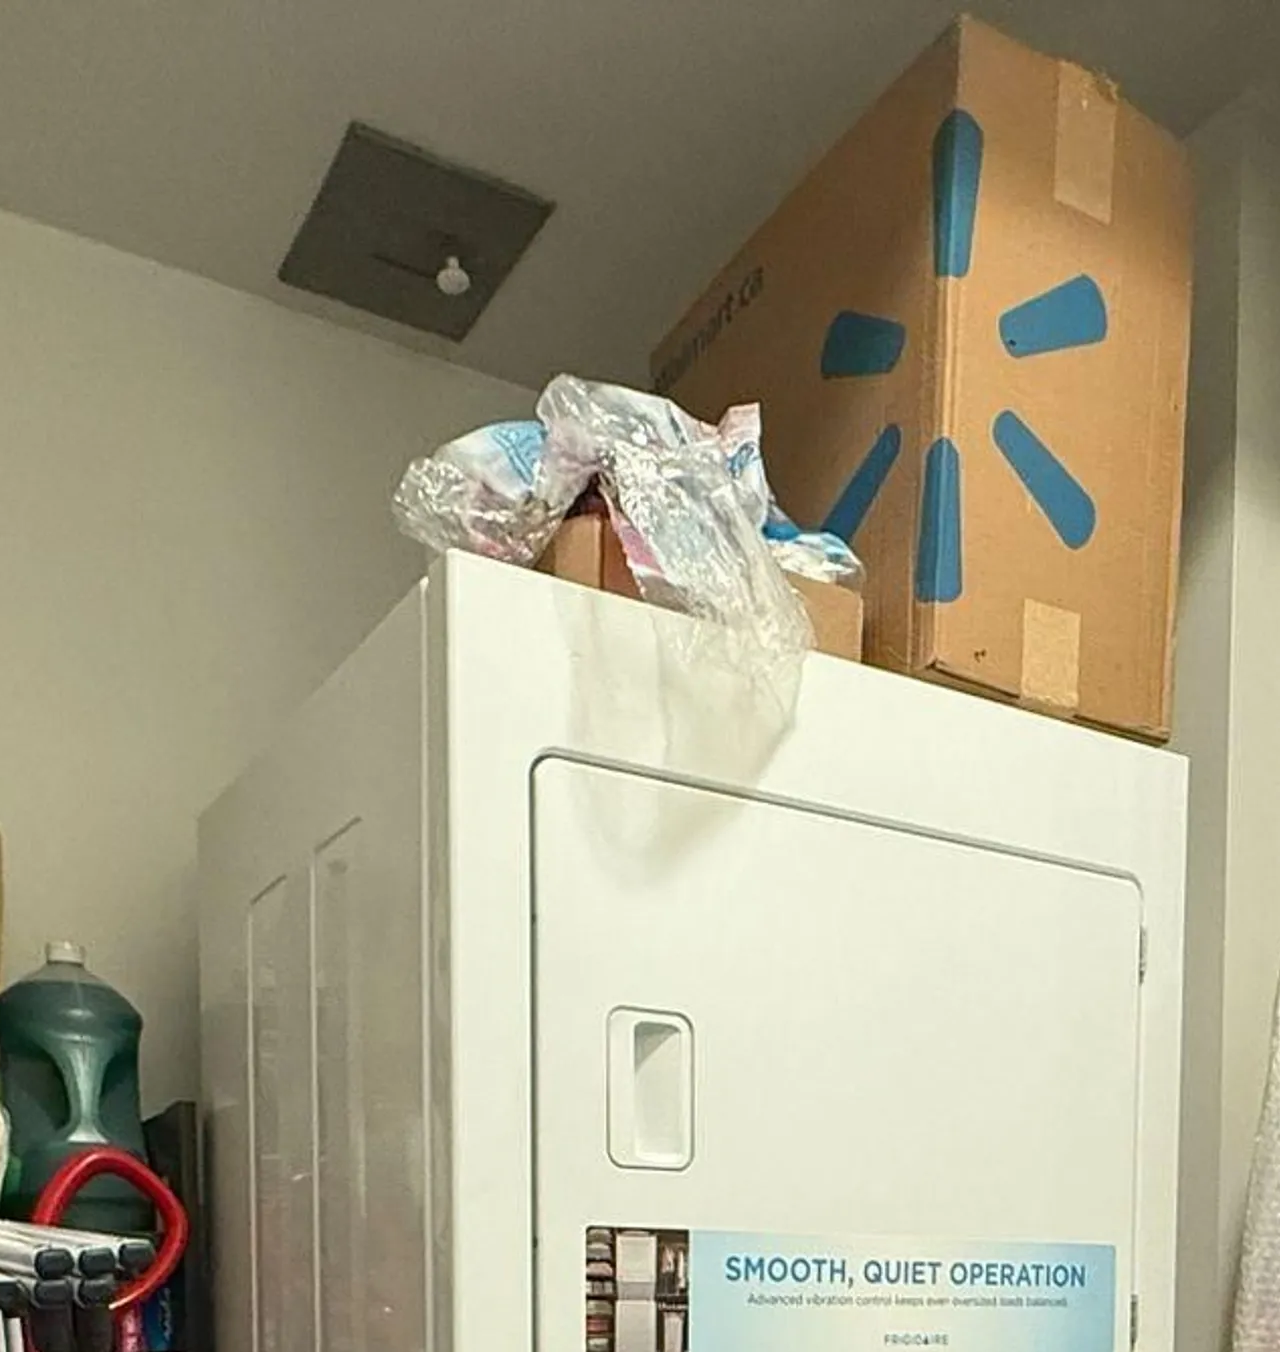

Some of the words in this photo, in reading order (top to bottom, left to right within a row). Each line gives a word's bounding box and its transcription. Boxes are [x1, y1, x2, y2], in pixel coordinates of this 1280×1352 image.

[726, 1255, 854, 1288] SMOOTH,
[864, 1260, 942, 1285] QUIET
[950, 1262, 1086, 1288] OPERATION
[748, 1294, 803, 1307] Advanced
[883, 1333, 949, 1346] FRIGIDAIRE
